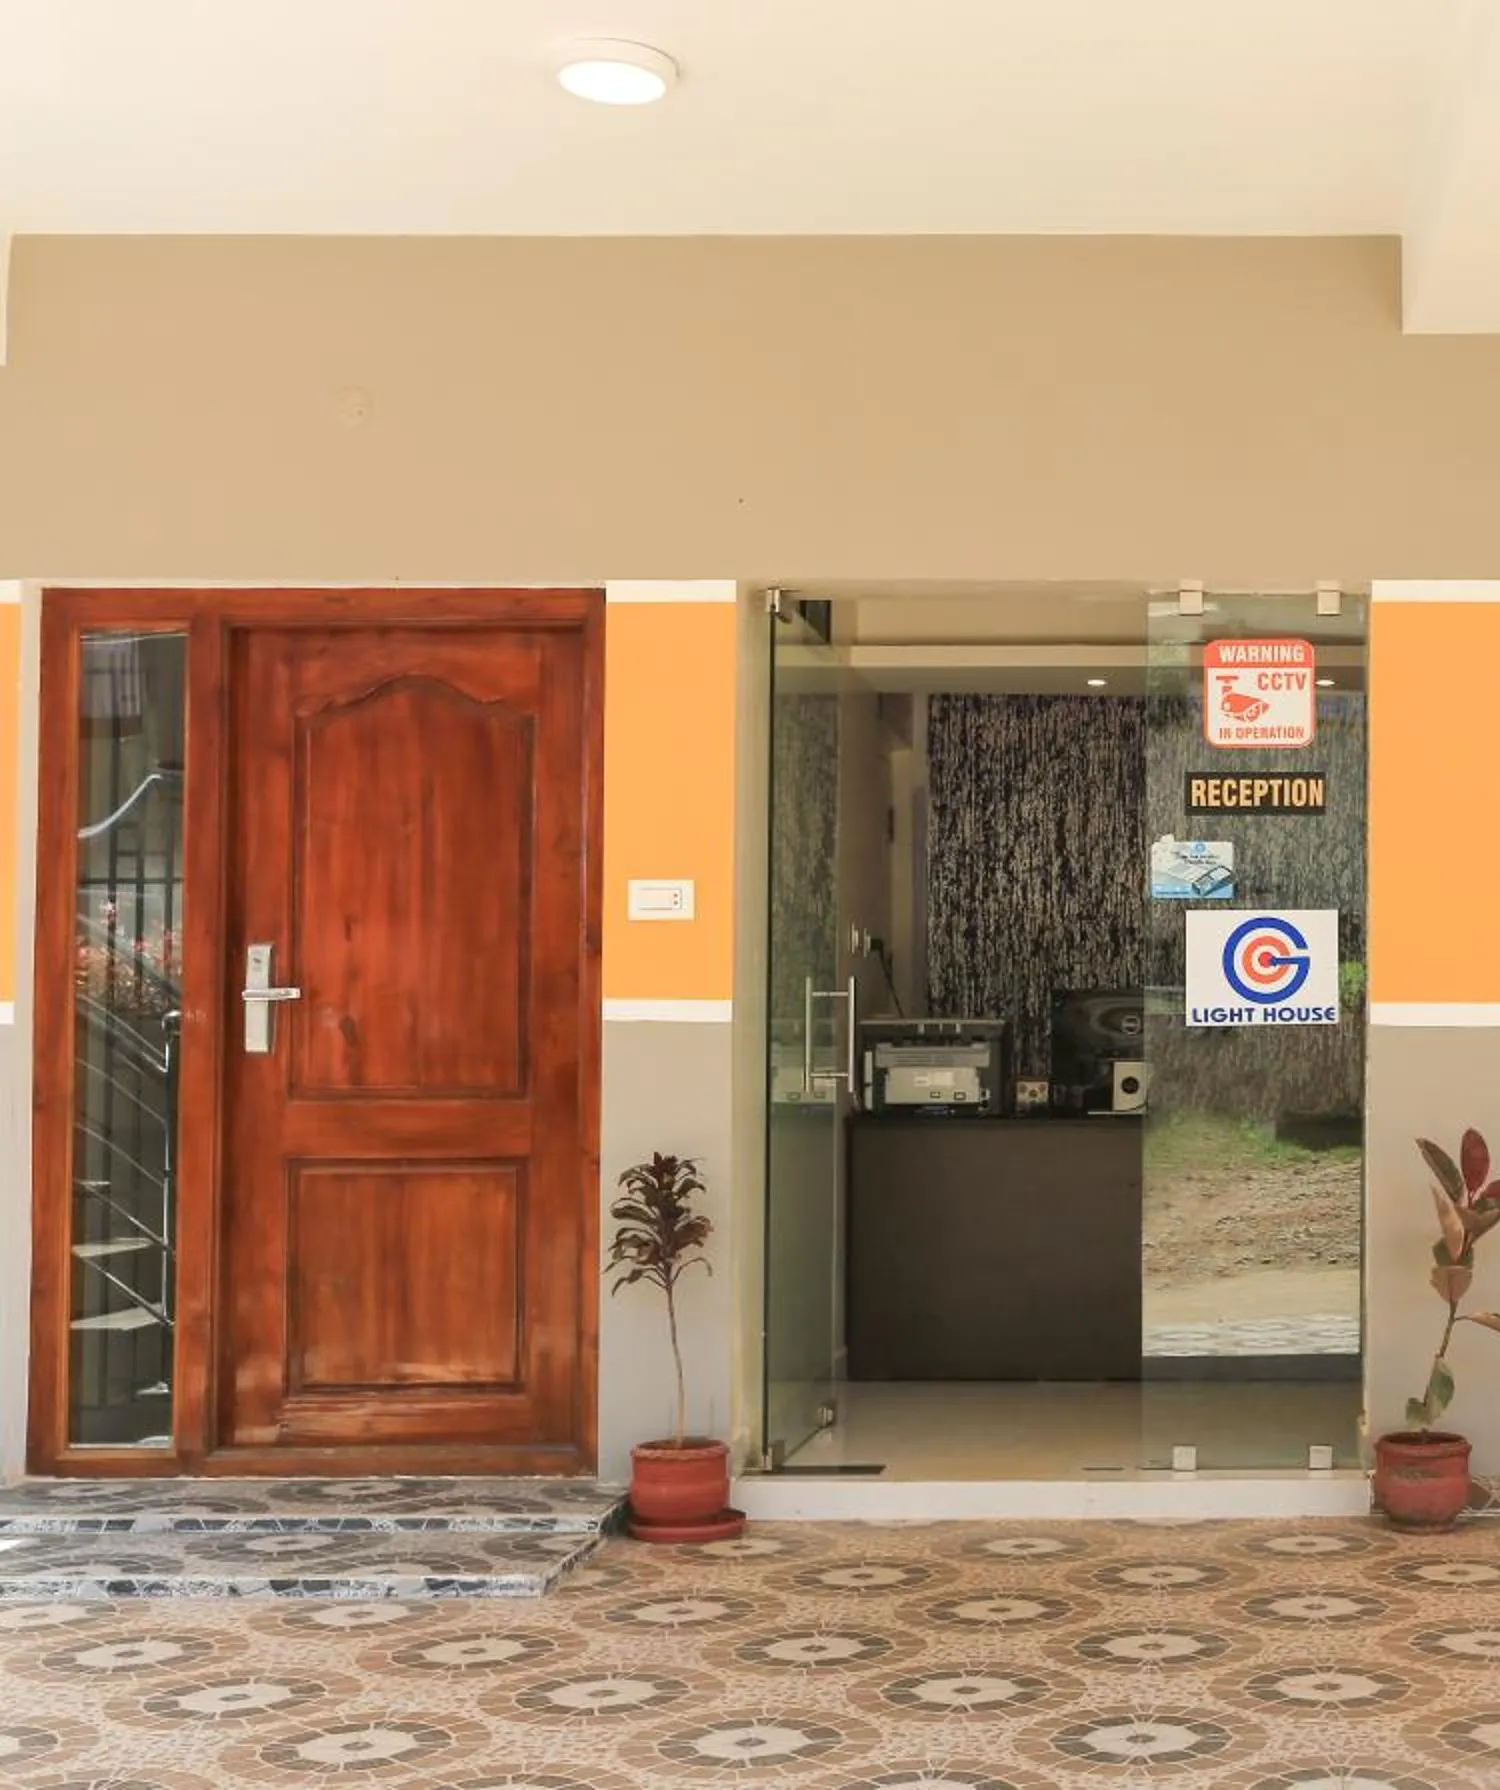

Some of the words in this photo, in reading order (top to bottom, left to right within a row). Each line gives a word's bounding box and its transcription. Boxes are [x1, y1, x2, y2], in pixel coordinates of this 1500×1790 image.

[1219, 645, 1305, 663] WARNING
[1257, 672, 1307, 691] CCTV
[1219, 727, 1231, 739] IN
[1235, 725, 1305, 739] OPERATION
[1191, 778, 1325, 808] RECEPTION
[1192, 1008, 1255, 1022] LIGHT
[1264, 1007, 1336, 1021] HOUSE
